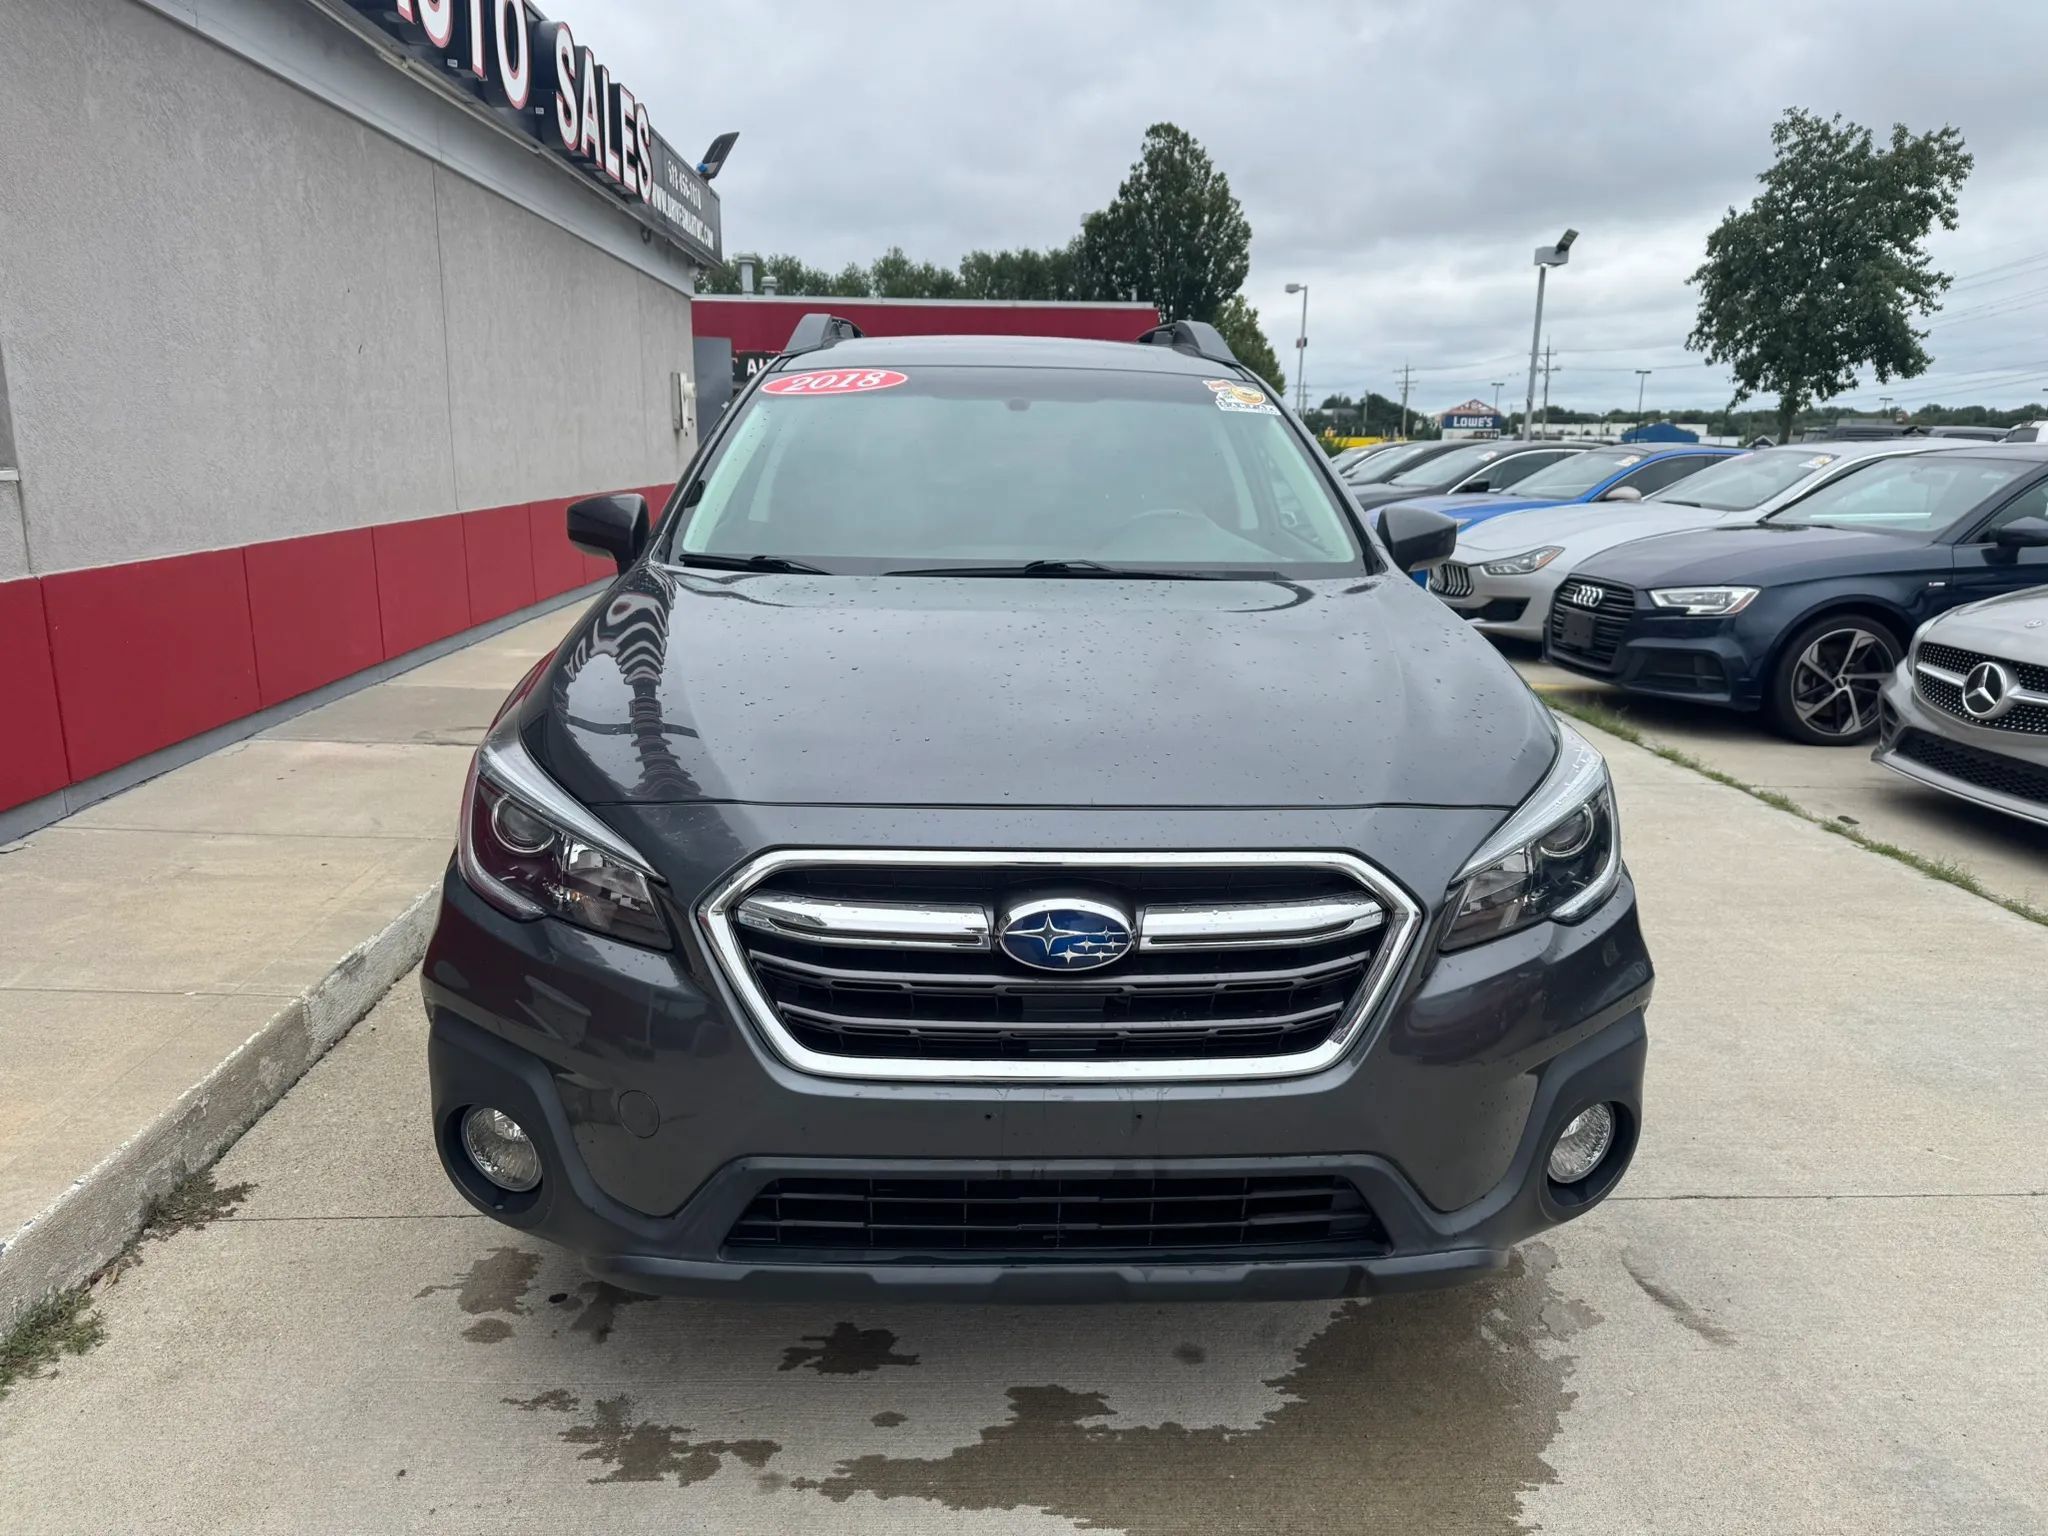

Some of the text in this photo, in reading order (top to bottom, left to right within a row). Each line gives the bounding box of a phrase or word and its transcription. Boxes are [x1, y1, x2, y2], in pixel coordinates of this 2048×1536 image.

[555, 21, 654, 205] SALES
[784, 372, 886, 392] 2018
[1453, 415, 1493, 428] LOWE'S
